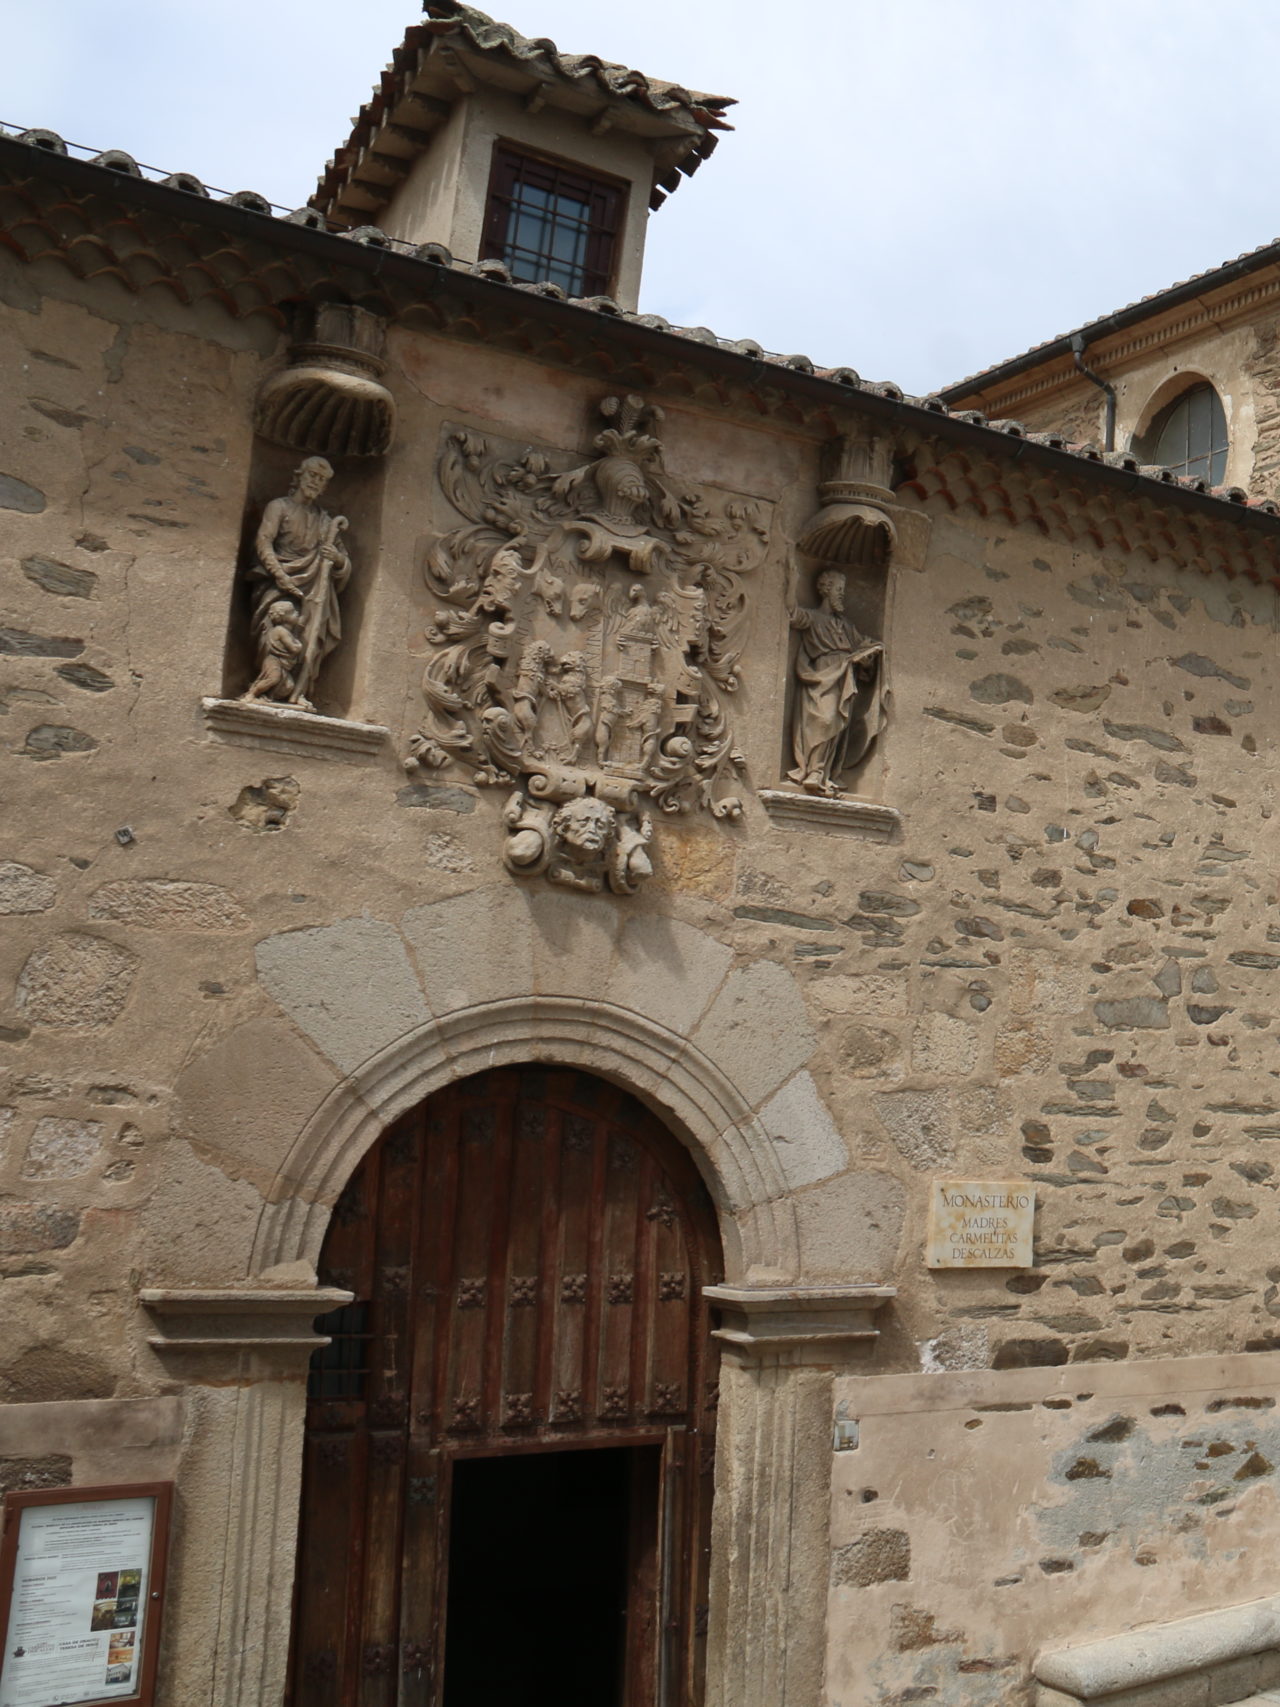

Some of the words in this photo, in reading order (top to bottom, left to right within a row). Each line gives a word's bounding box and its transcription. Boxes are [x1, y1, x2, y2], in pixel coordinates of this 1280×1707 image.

[942, 1194, 1029, 1210] MONASTERIO
[962, 1217, 1008, 1230] MADRES
[949, 1232, 1018, 1245] CARMELITAS
[952, 1247, 1015, 1260] DESCALZAS
